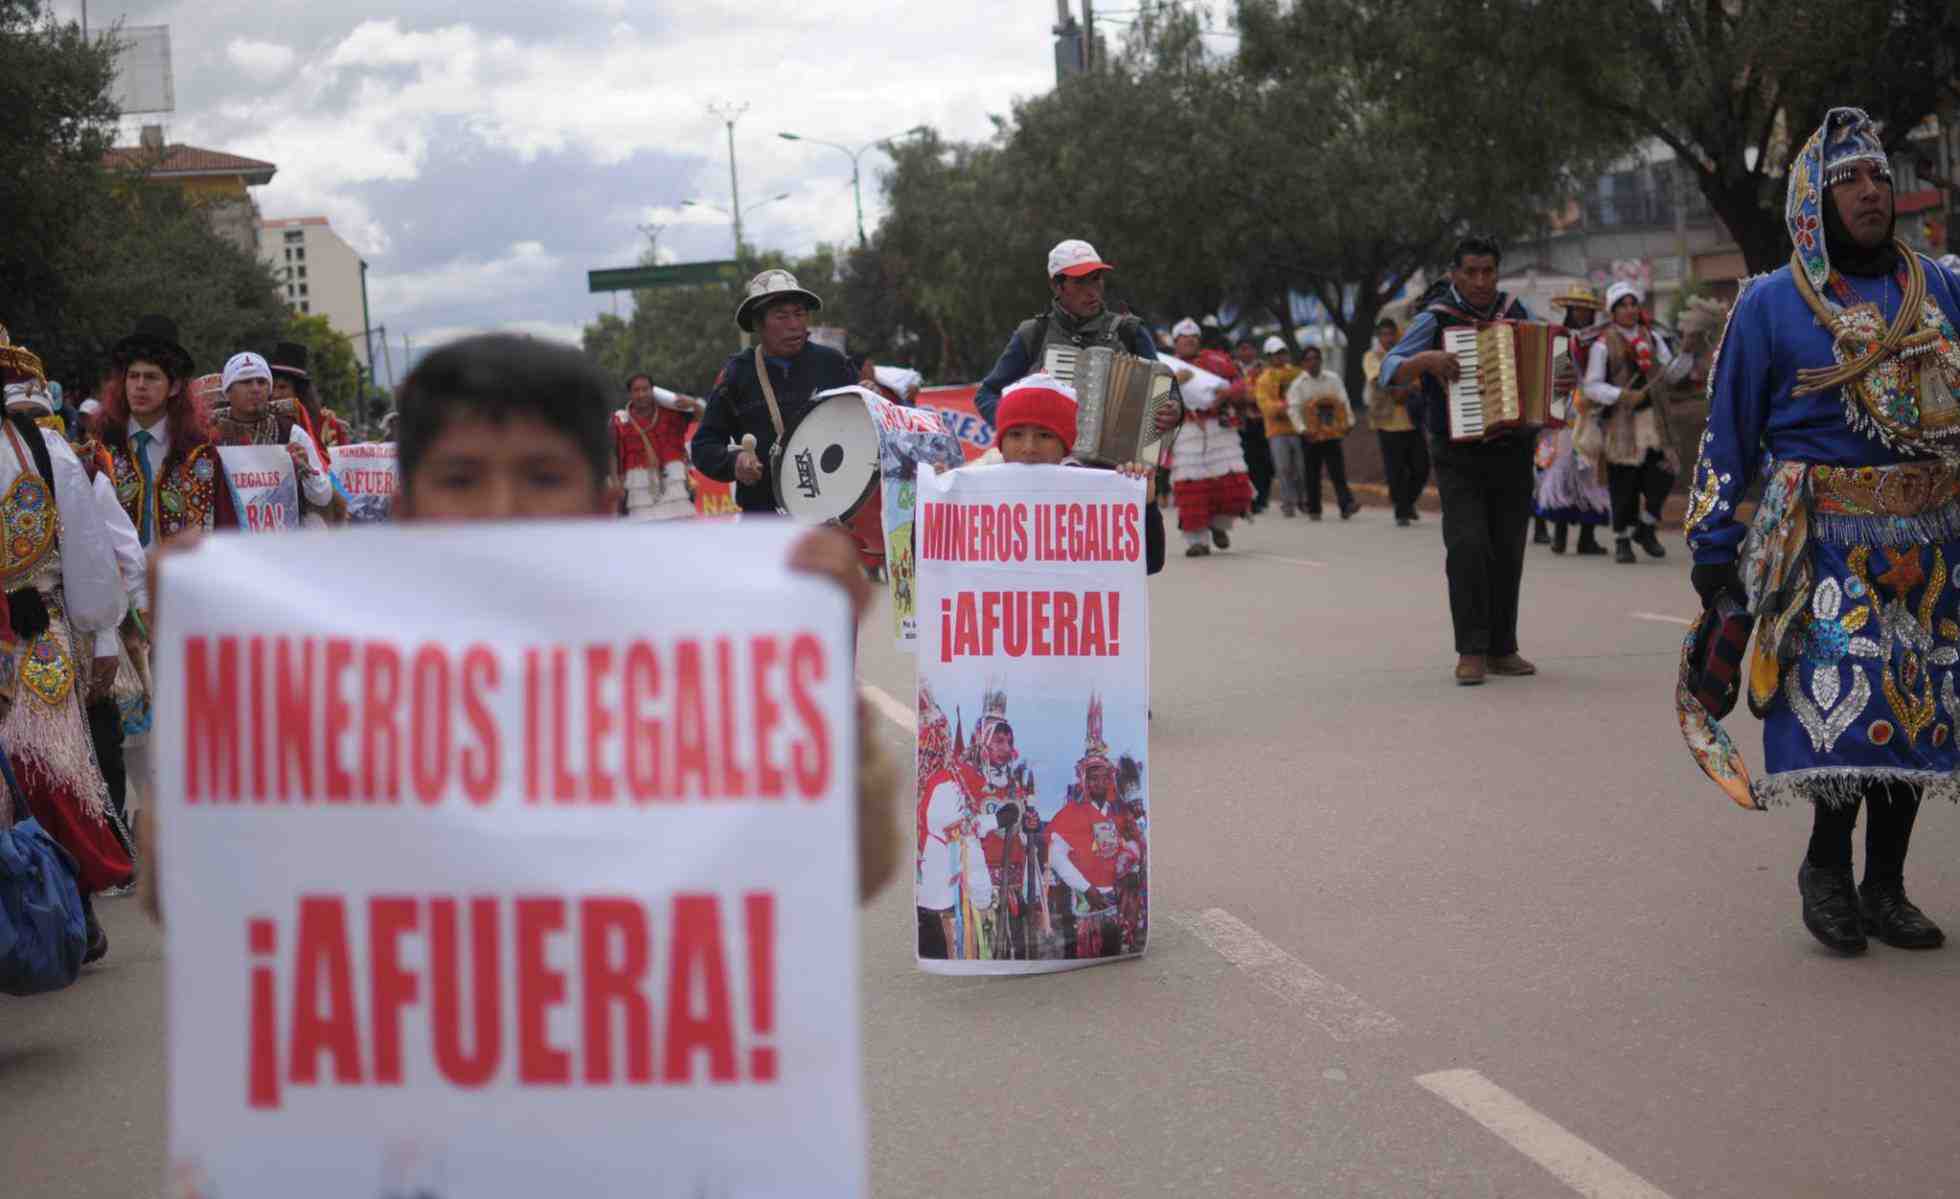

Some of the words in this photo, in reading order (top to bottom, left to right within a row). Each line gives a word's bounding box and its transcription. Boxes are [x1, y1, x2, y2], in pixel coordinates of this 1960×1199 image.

[245, 502, 285, 530] RA!
[923, 501, 1028, 562] MINEROS
[1035, 502, 1140, 561] ILEGALES
[940, 591, 1119, 663] ¡AFUERA!
[185, 636, 500, 805] MINEROS
[524, 634, 831, 804] ILEGALES
[249, 892, 776, 1108] ¡AFUERA!
